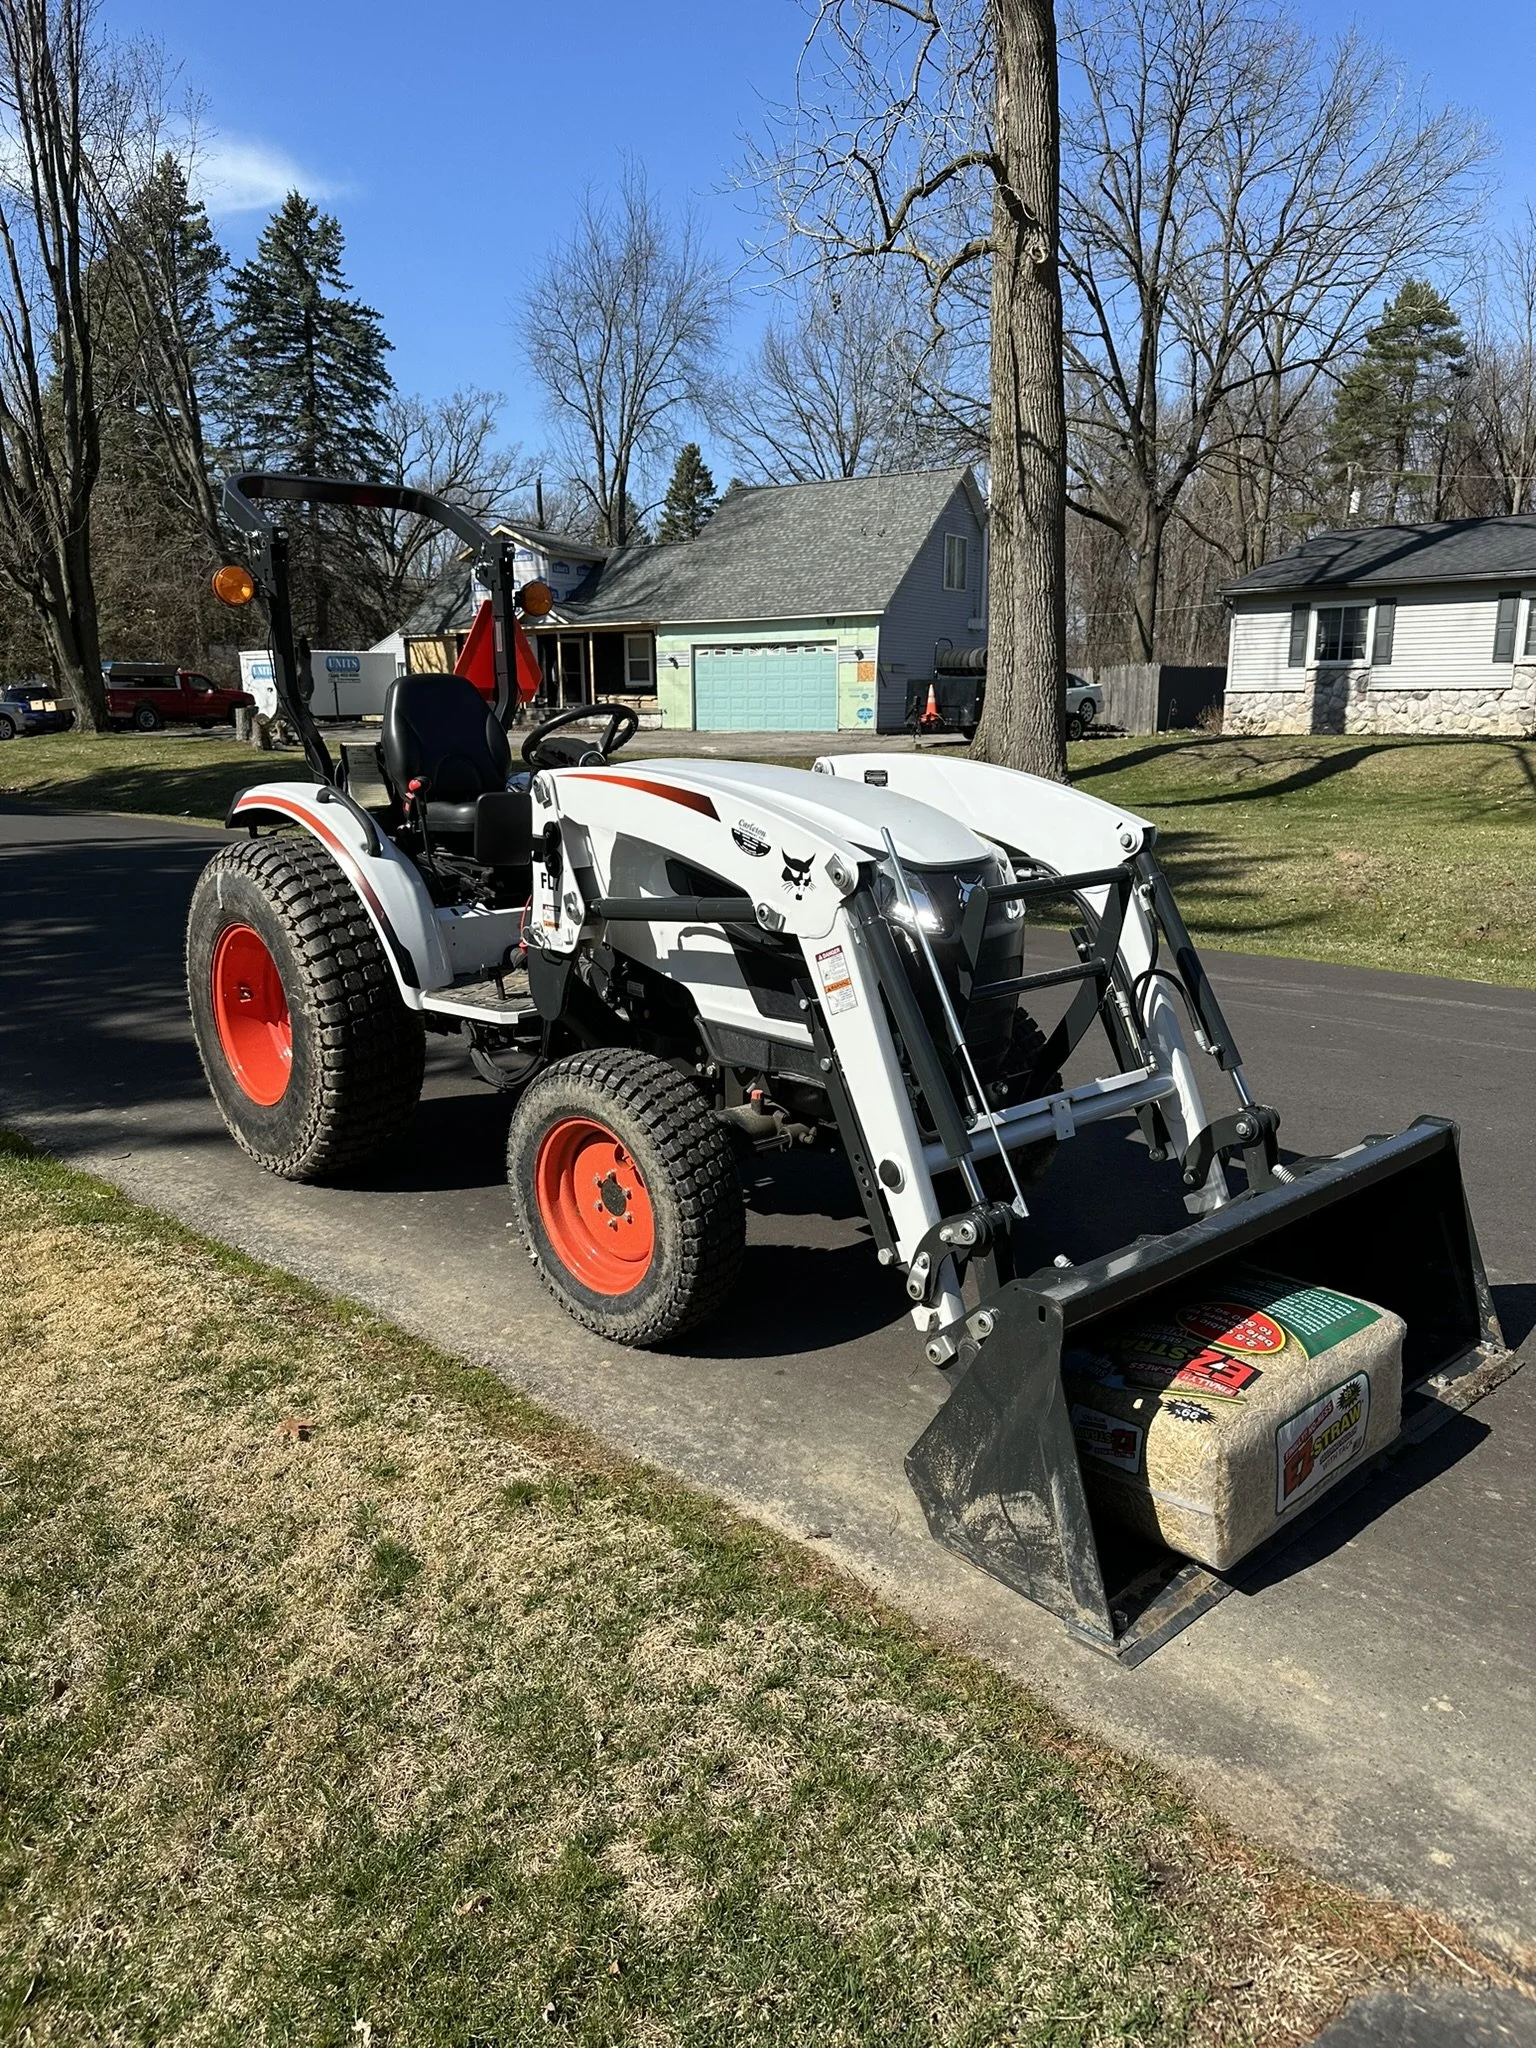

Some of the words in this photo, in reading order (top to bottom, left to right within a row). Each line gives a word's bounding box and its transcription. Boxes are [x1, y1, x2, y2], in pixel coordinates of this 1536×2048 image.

[328, 656, 358, 668] UNITS
[738, 819, 766, 837] Carleton
[1246, 1328, 1275, 1347] bale
[1258, 1326, 1273, 1336] to
[1233, 1333, 1257, 1347] 2.5
[1175, 1407, 1201, 1420] 99%
